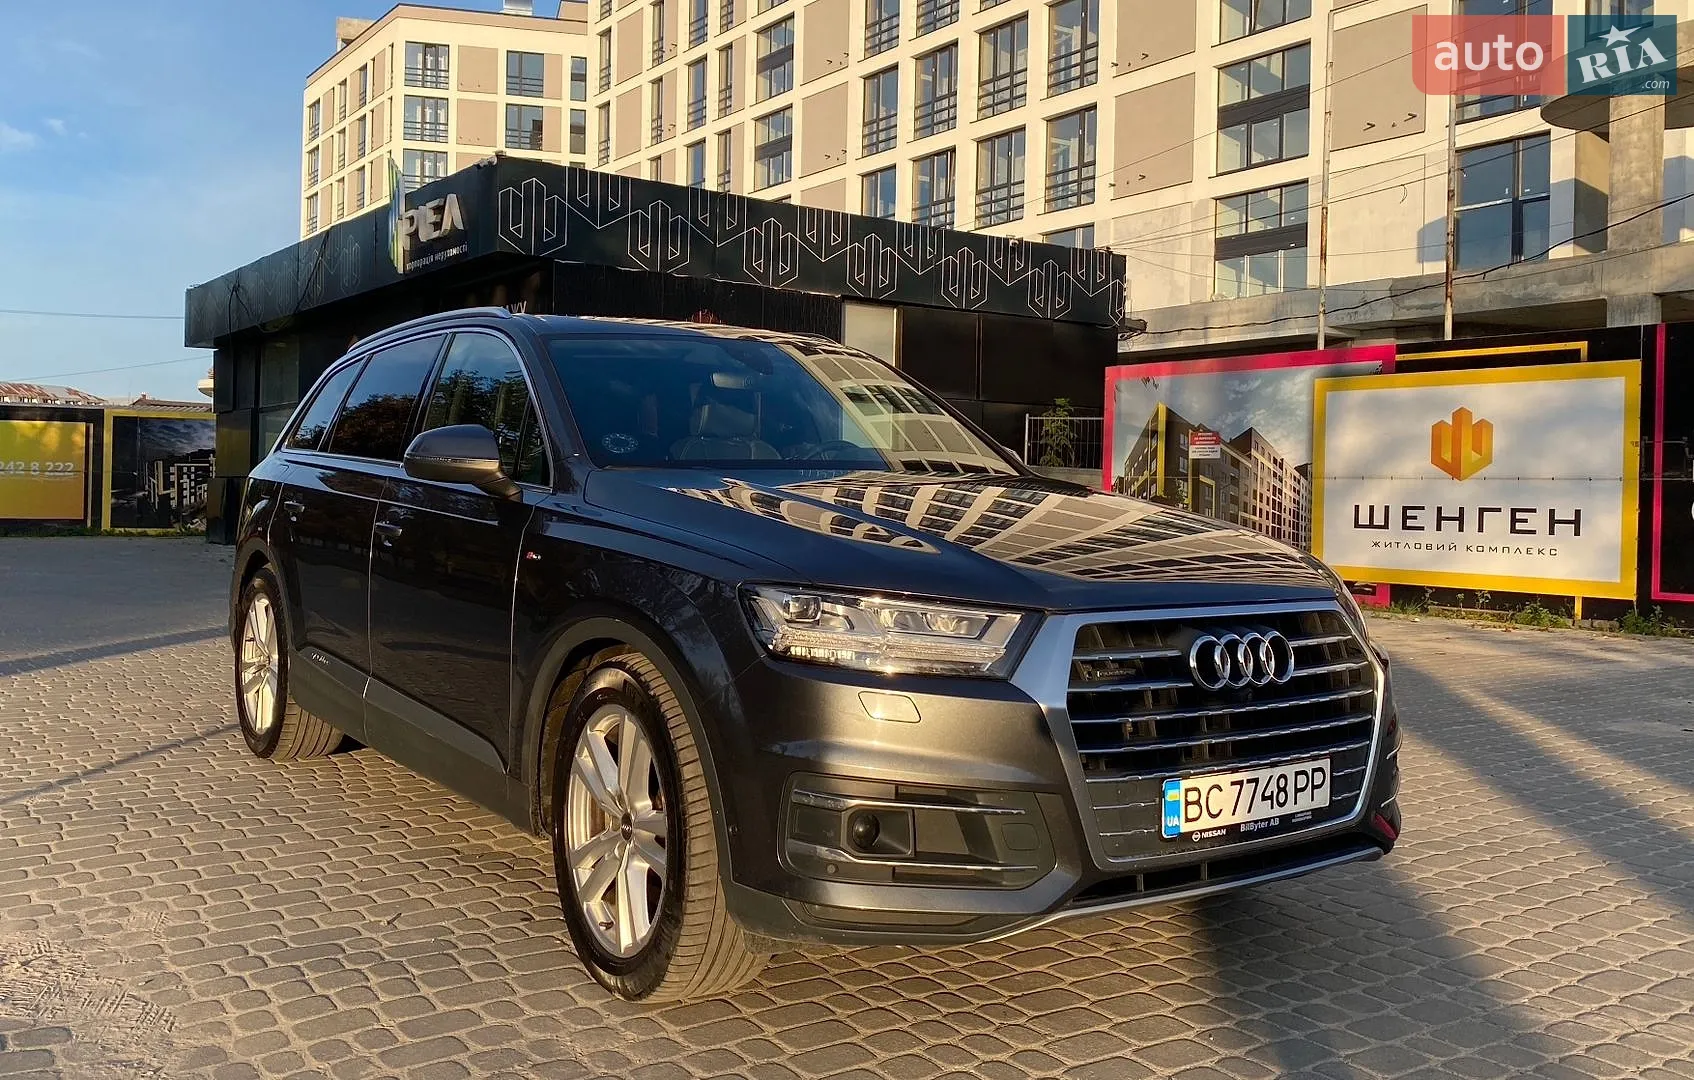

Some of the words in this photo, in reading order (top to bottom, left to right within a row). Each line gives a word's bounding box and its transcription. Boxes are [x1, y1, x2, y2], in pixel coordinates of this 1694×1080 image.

[31, 461, 40, 475] 8
[1353, 504, 1582, 537] ШЕНГЕН
[1371, 540, 1457, 552] ЖИТЛОВИЙ
[1466, 544, 1558, 556] КОМПЛЕКС
[1184, 784, 1223, 823] BC
[1230, 773, 1289, 816] 7748
[1294, 766, 1327, 805] PP
[1167, 816, 1180, 827] UA
[1269, 817, 1280, 827] AB
[1201, 829, 1227, 839] NISSAN
